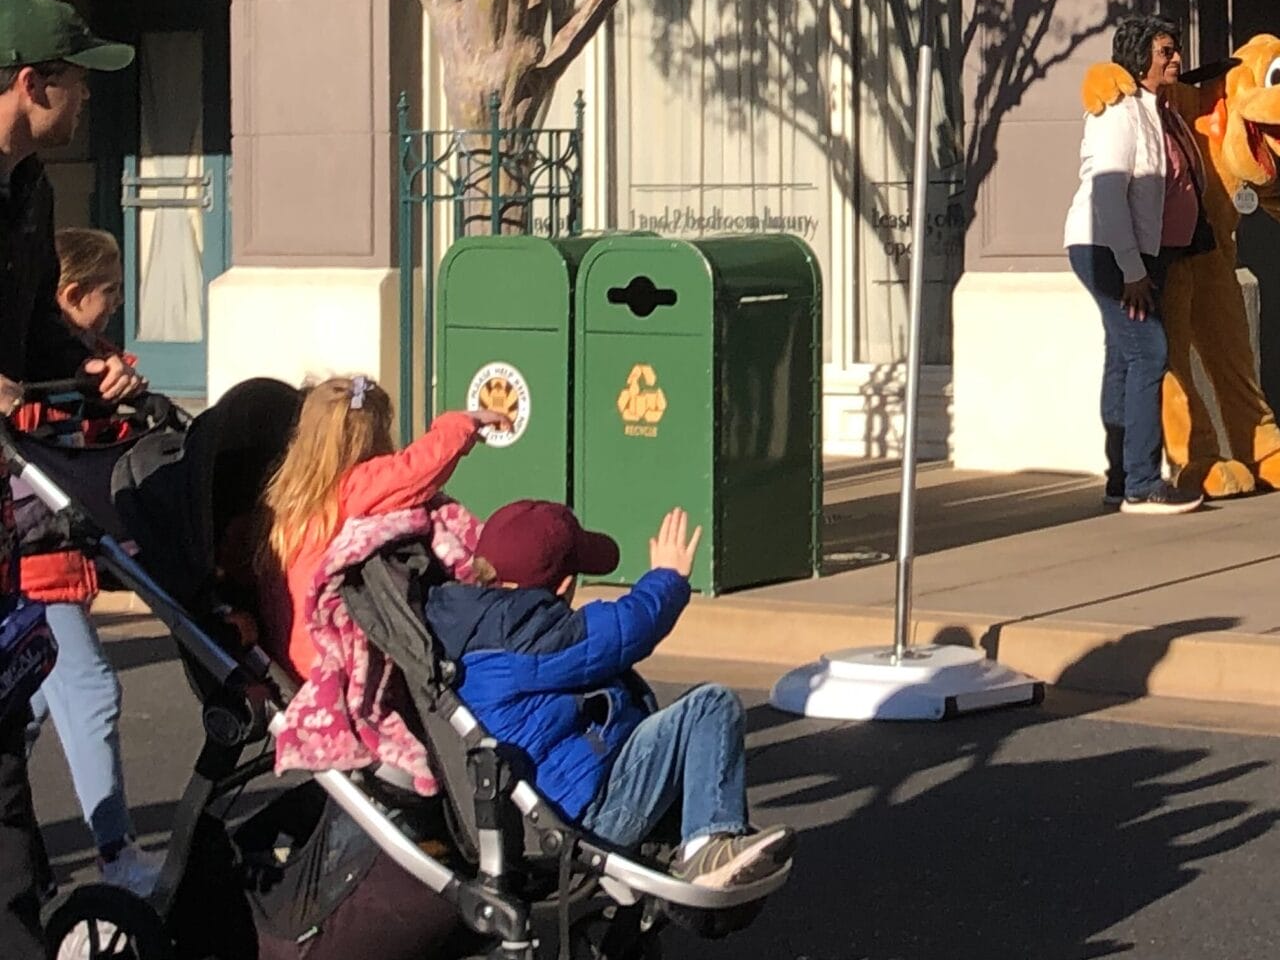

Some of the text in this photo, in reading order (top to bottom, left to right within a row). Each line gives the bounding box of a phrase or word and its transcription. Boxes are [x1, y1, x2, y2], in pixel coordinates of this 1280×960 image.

[639, 205, 671, 230] and
[685, 204, 760, 230] bedroom
[763, 204, 813, 236] luxury
